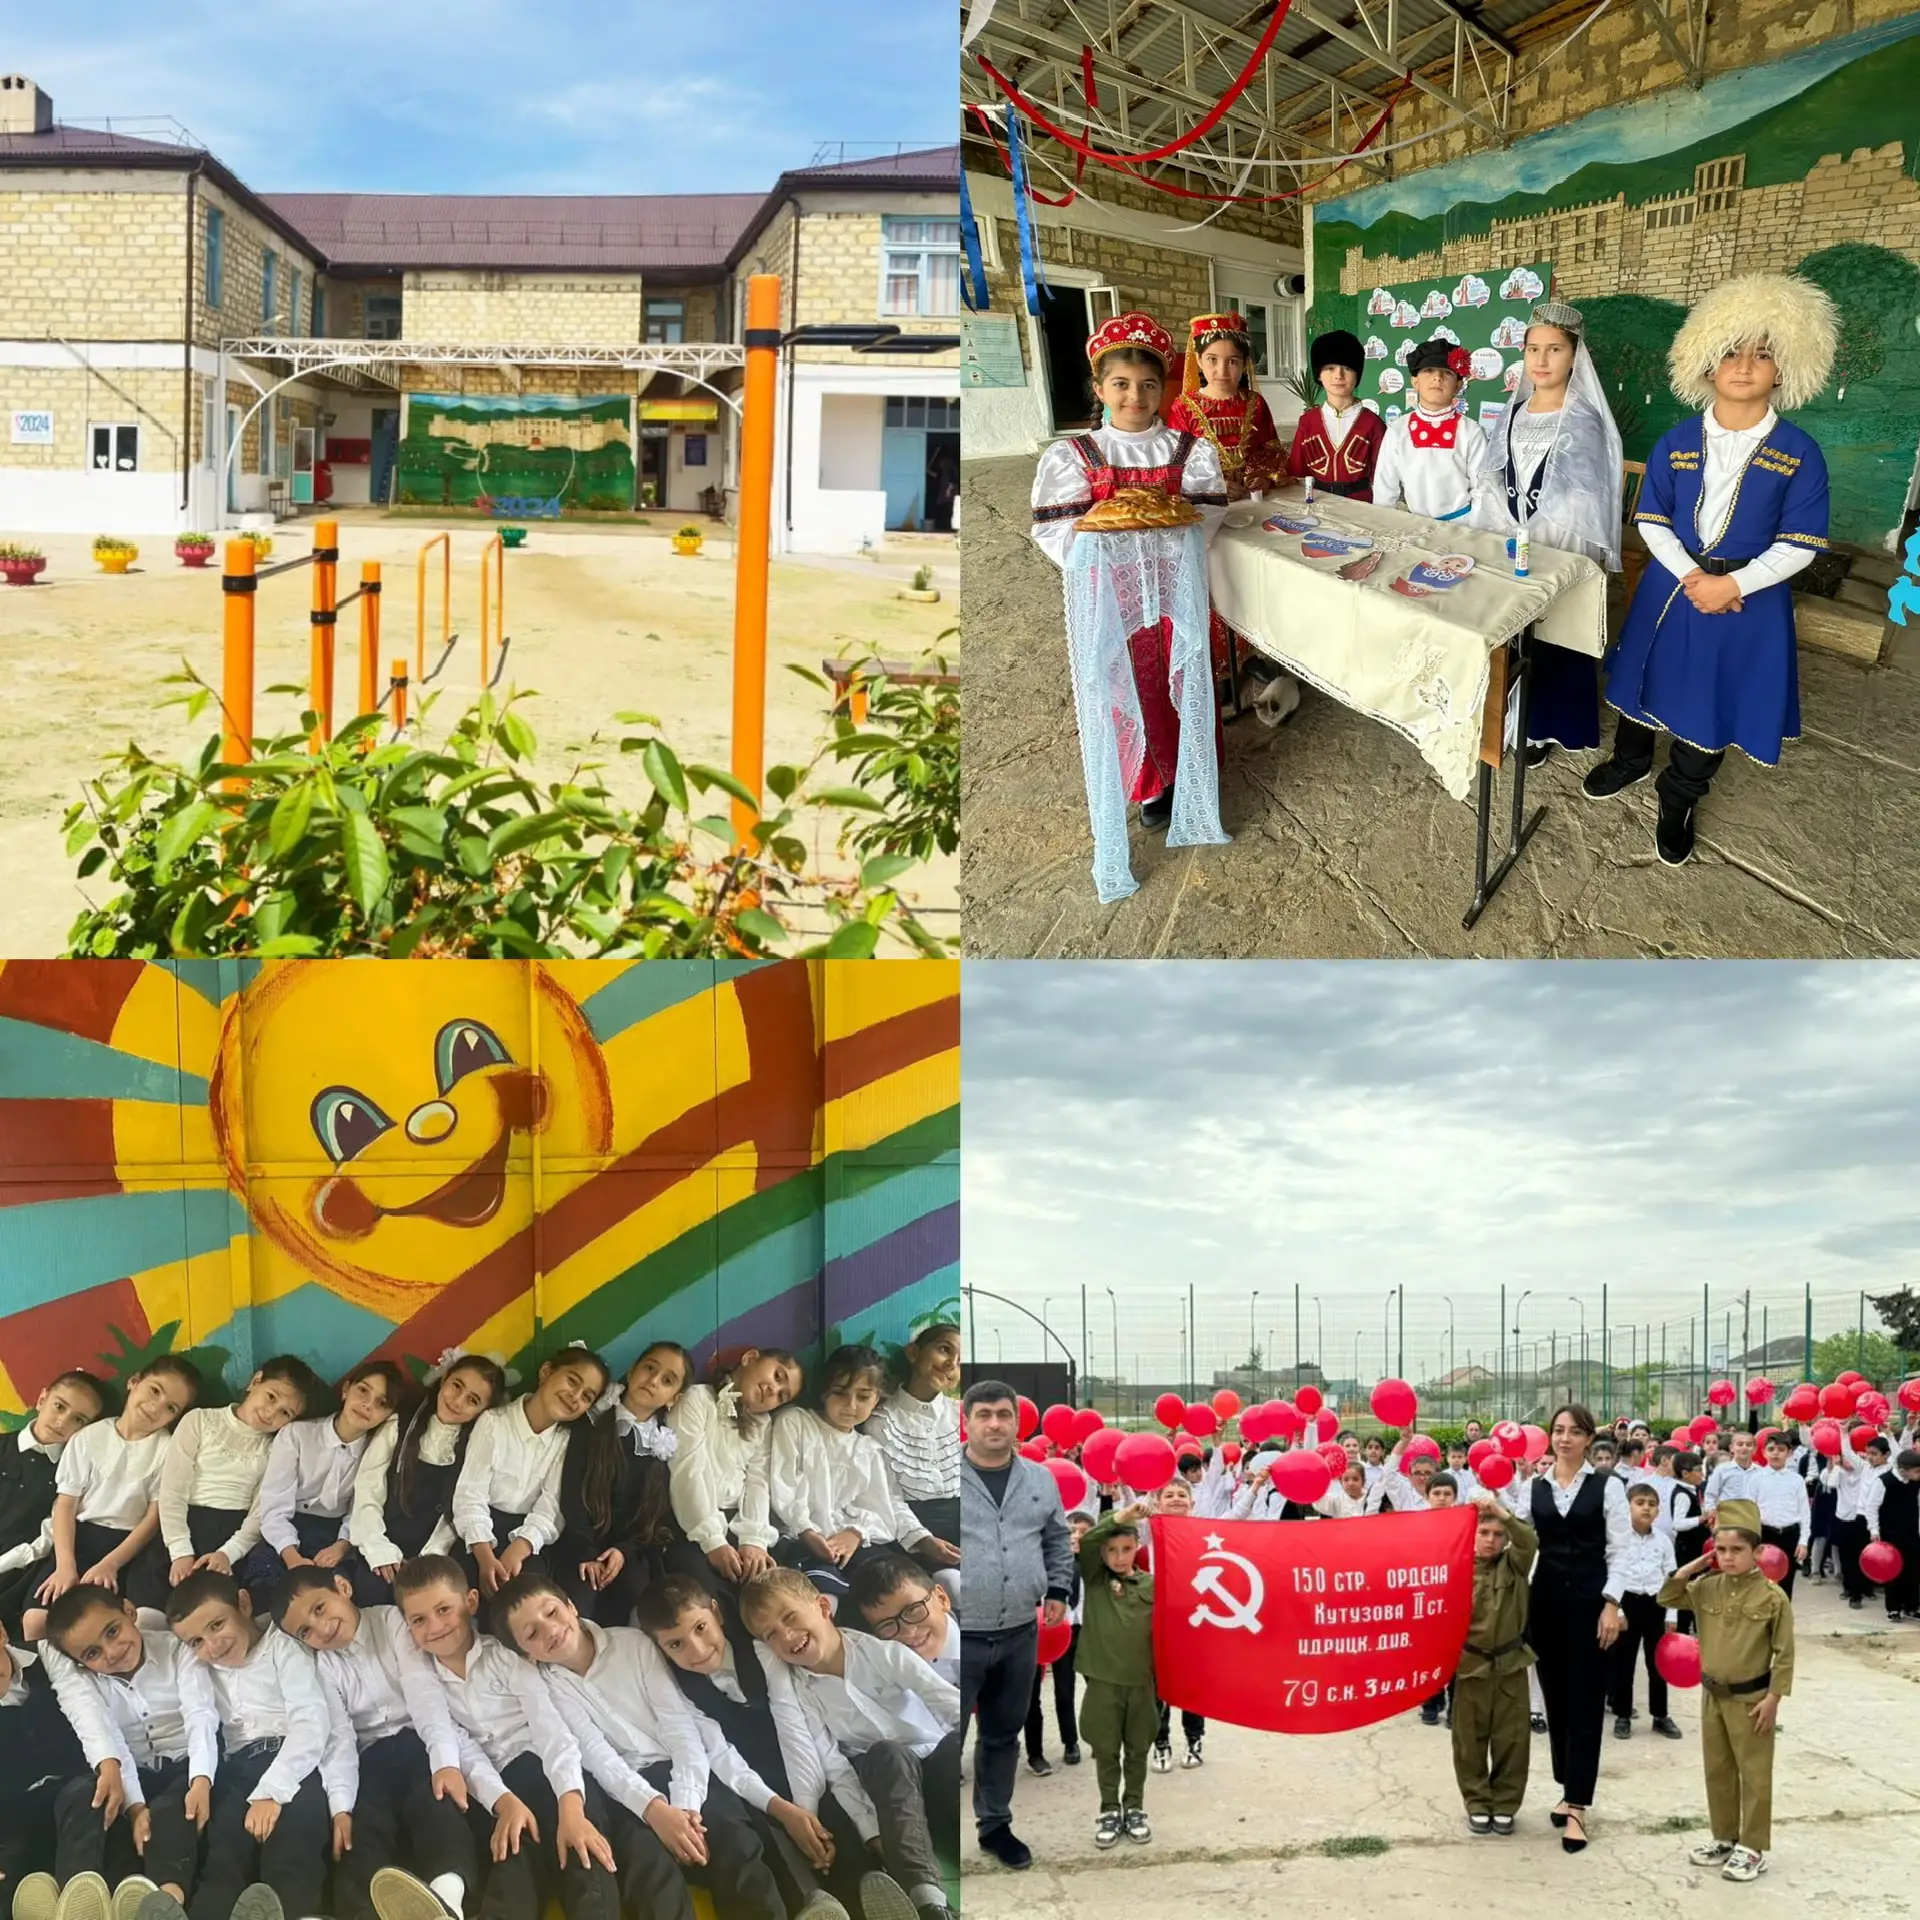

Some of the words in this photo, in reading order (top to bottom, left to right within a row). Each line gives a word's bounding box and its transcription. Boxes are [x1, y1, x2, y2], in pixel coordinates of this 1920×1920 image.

[20, 414, 49, 432] 2024
[1292, 1567, 1326, 1593] 150
[1334, 1571, 1371, 1592] СТР.
[1387, 1564, 1449, 1589] ОРДЕНА
[1282, 1679, 1318, 1707] 79
